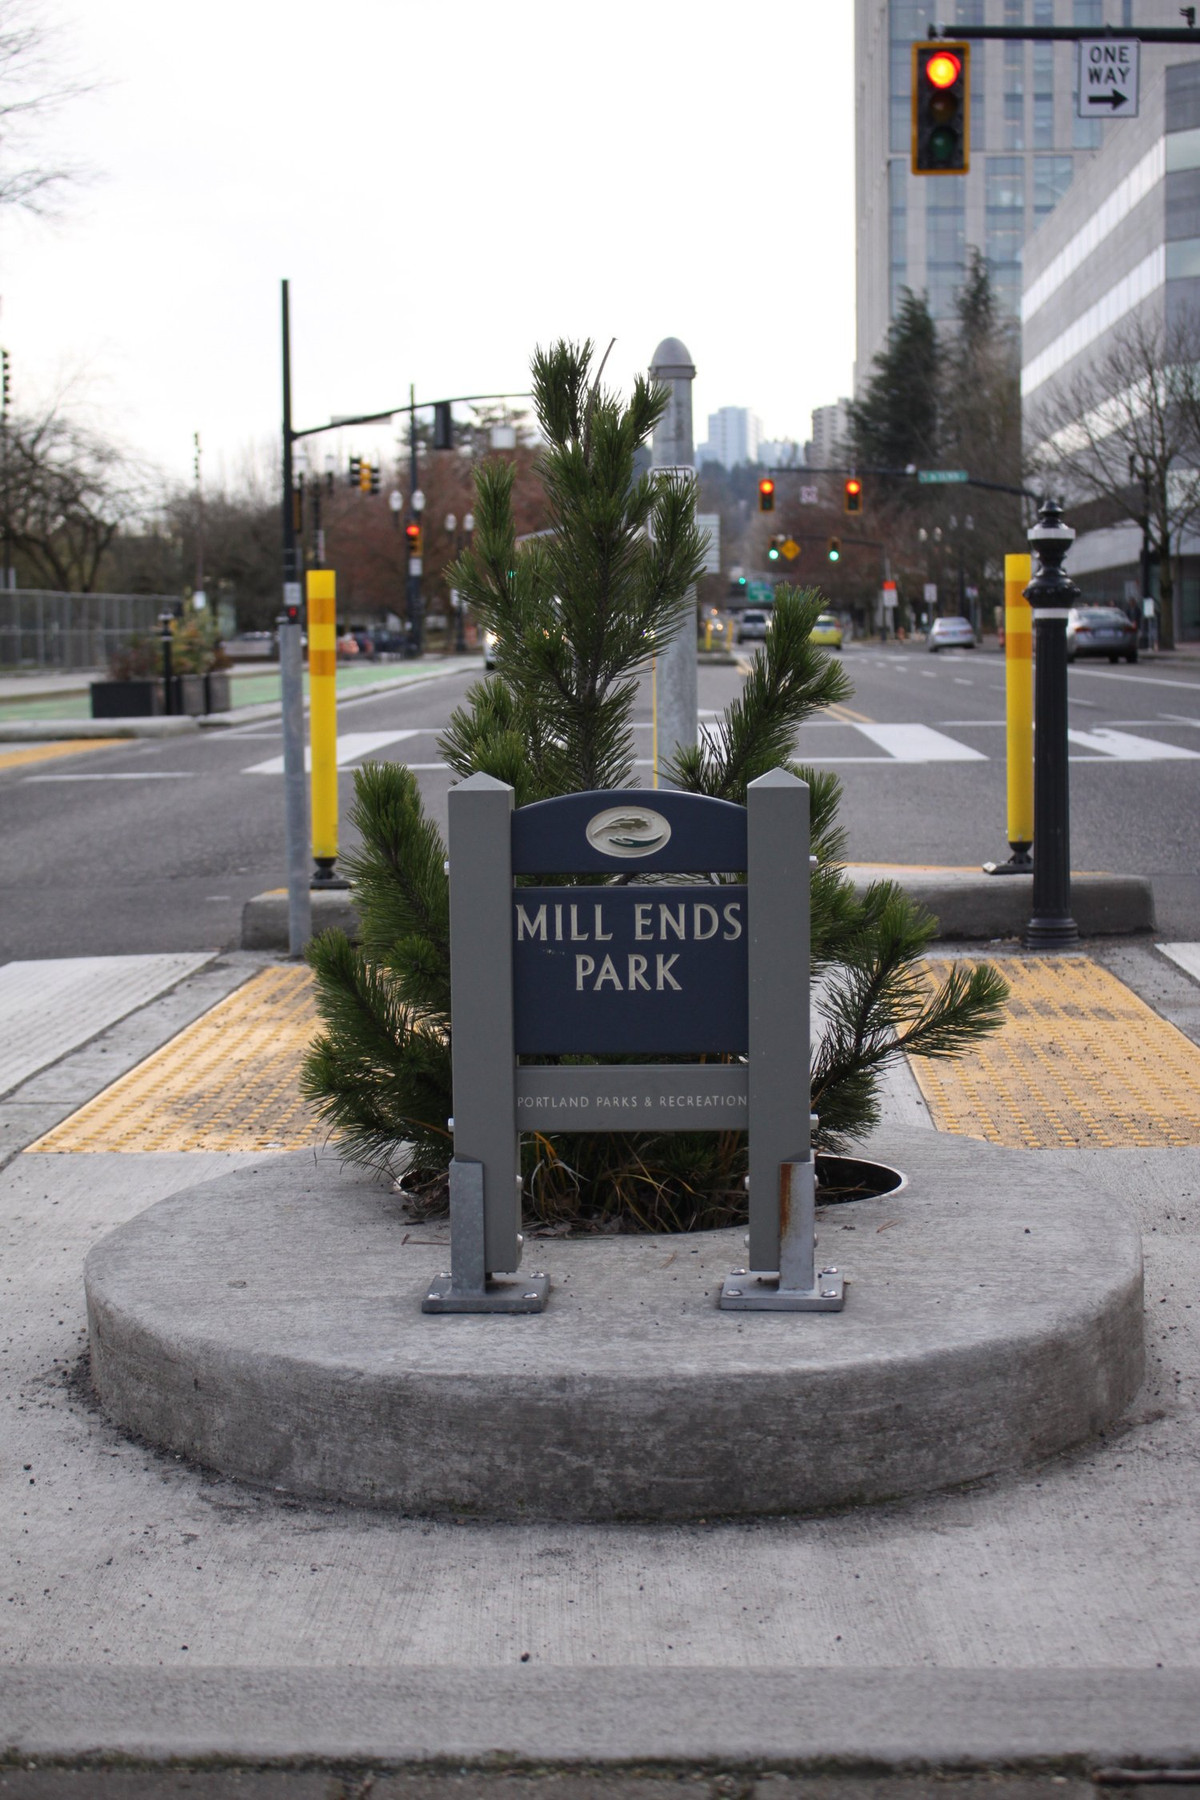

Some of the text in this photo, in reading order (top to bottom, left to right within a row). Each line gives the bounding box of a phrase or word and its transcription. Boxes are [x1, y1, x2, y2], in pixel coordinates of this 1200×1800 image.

[1089, 45, 1129, 64] ONE
[1087, 66, 1130, 85] WAY
[515, 903, 742, 941] MILL ENDS
[575, 953, 682, 991] PARK
[517, 1095, 747, 1108] PORTLAND PARKS & RECREATION
